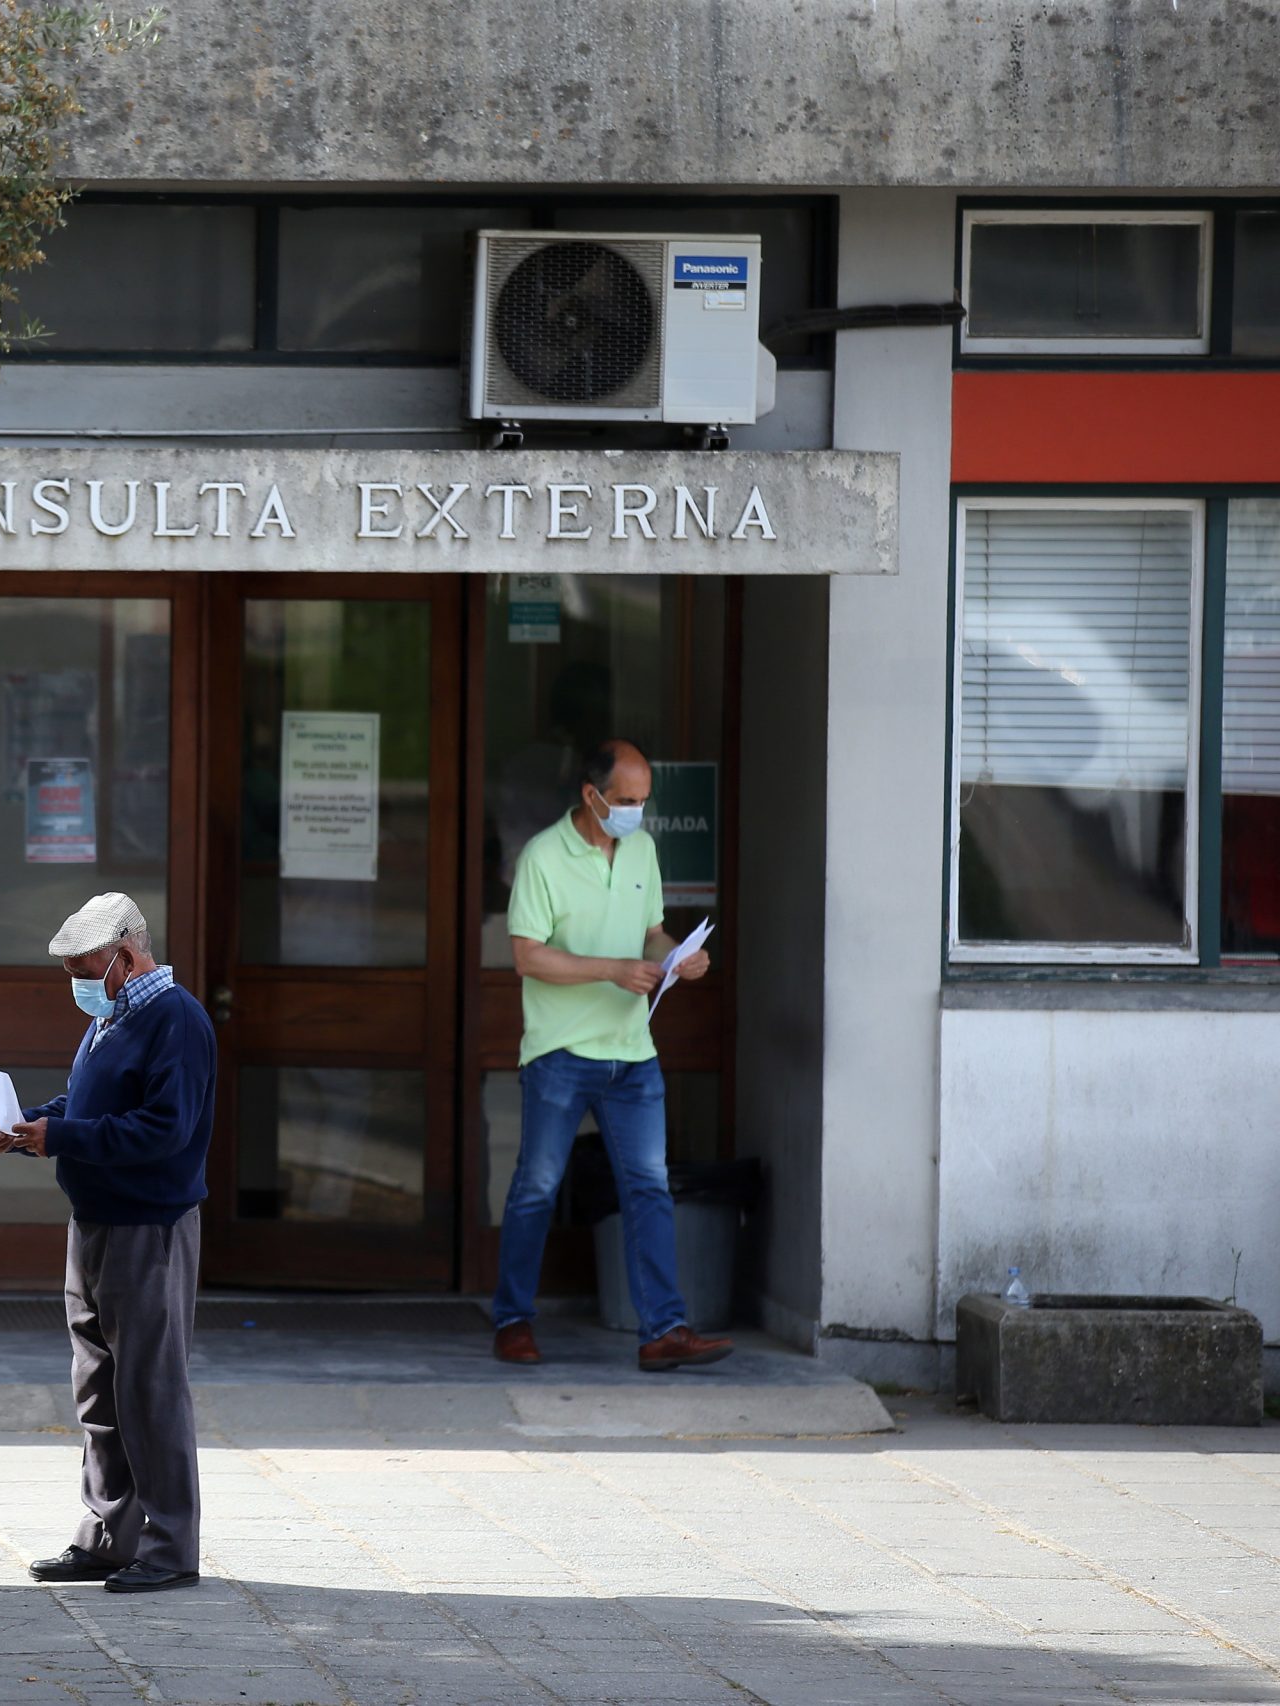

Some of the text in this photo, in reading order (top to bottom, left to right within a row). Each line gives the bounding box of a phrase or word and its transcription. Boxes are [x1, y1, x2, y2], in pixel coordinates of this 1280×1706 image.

[682, 262, 739, 274] Panasonic
[691, 281, 730, 290] INVERTER
[355, 482, 778, 540] EXTERNA
